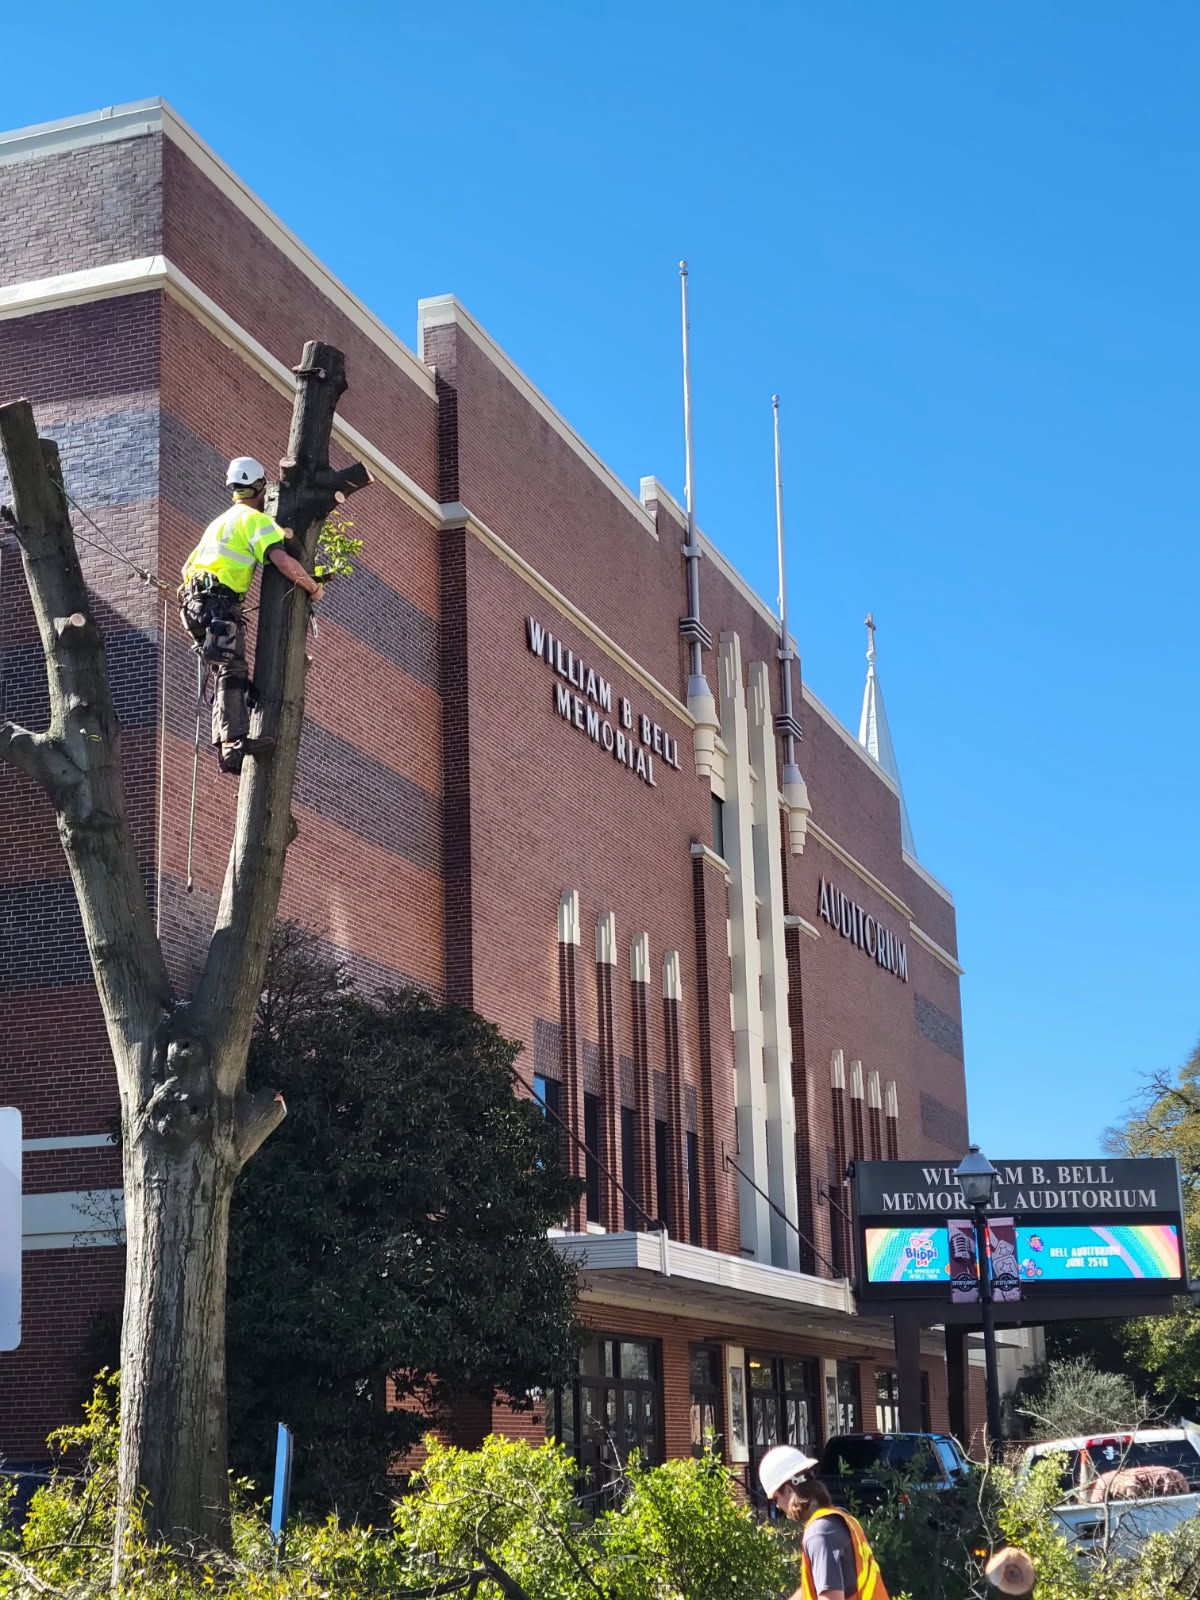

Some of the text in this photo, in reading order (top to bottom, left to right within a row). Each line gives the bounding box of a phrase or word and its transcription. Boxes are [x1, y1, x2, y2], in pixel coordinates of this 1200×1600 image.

[527, 615, 612, 713] WILLIAM
[641, 713, 682, 771] BELL
[555, 683, 657, 787] MEMORIAL
[819, 874, 909, 983] AUDITORIUM
[881, 1189, 1157, 1211] MEMORL AUDITORIUM
[1031, 1166, 1051, 1185] B.
[1057, 1165, 1114, 1185] BELL
[905, 1247, 938, 1261] Blippi
